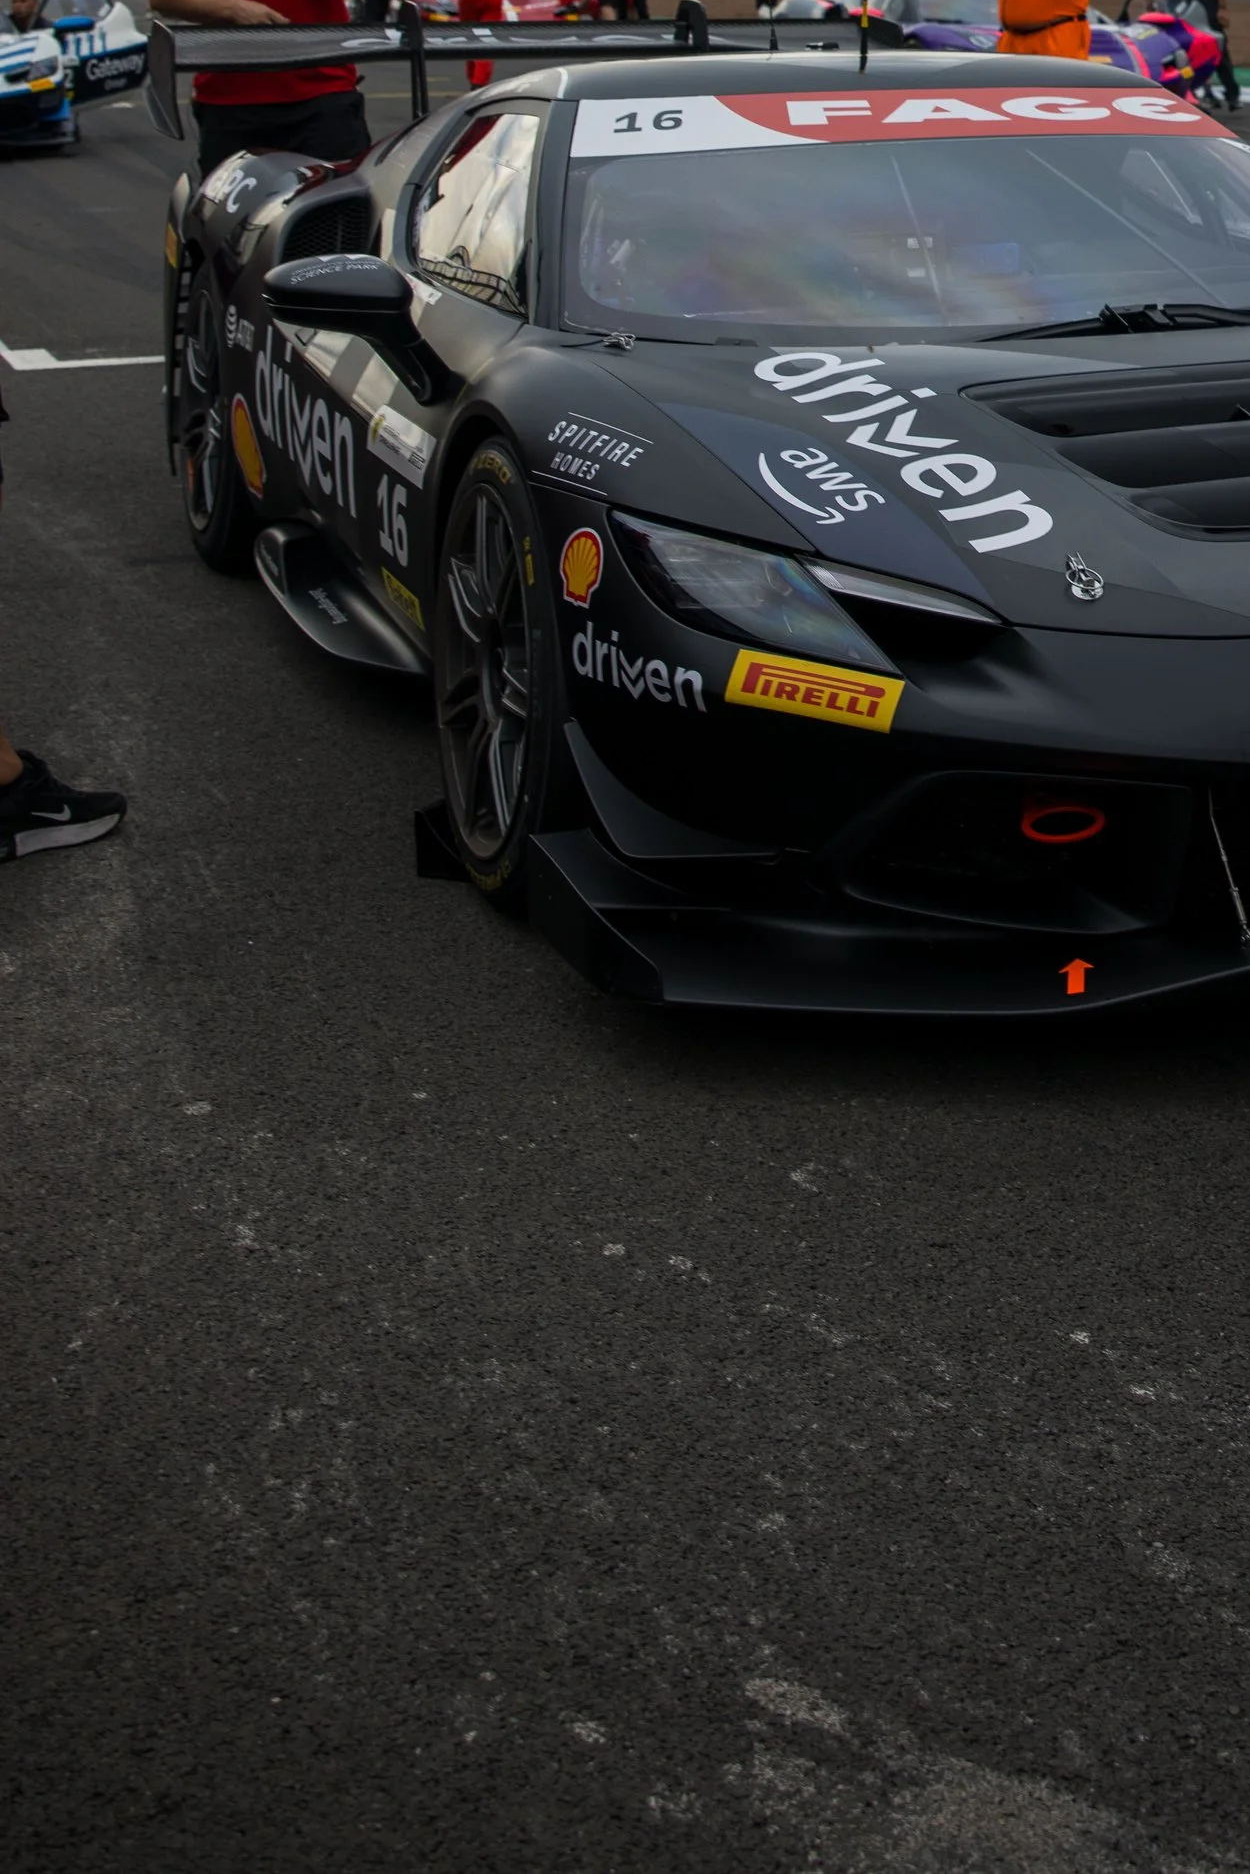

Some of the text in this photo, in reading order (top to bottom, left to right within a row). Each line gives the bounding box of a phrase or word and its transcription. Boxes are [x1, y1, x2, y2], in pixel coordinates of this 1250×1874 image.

[86, 53, 145, 81] Gateway
[613, 109, 684, 134] 16
[255, 325, 357, 519] driven
[547, 420, 645, 467] SPITFIRE
[550, 451, 601, 480] HOMES
[753, 352, 1053, 554] driven
[779, 447, 886, 512] aws
[376, 473, 409, 568] 16
[572, 621, 707, 713] driven
[740, 661, 887, 719] PIRELLI
